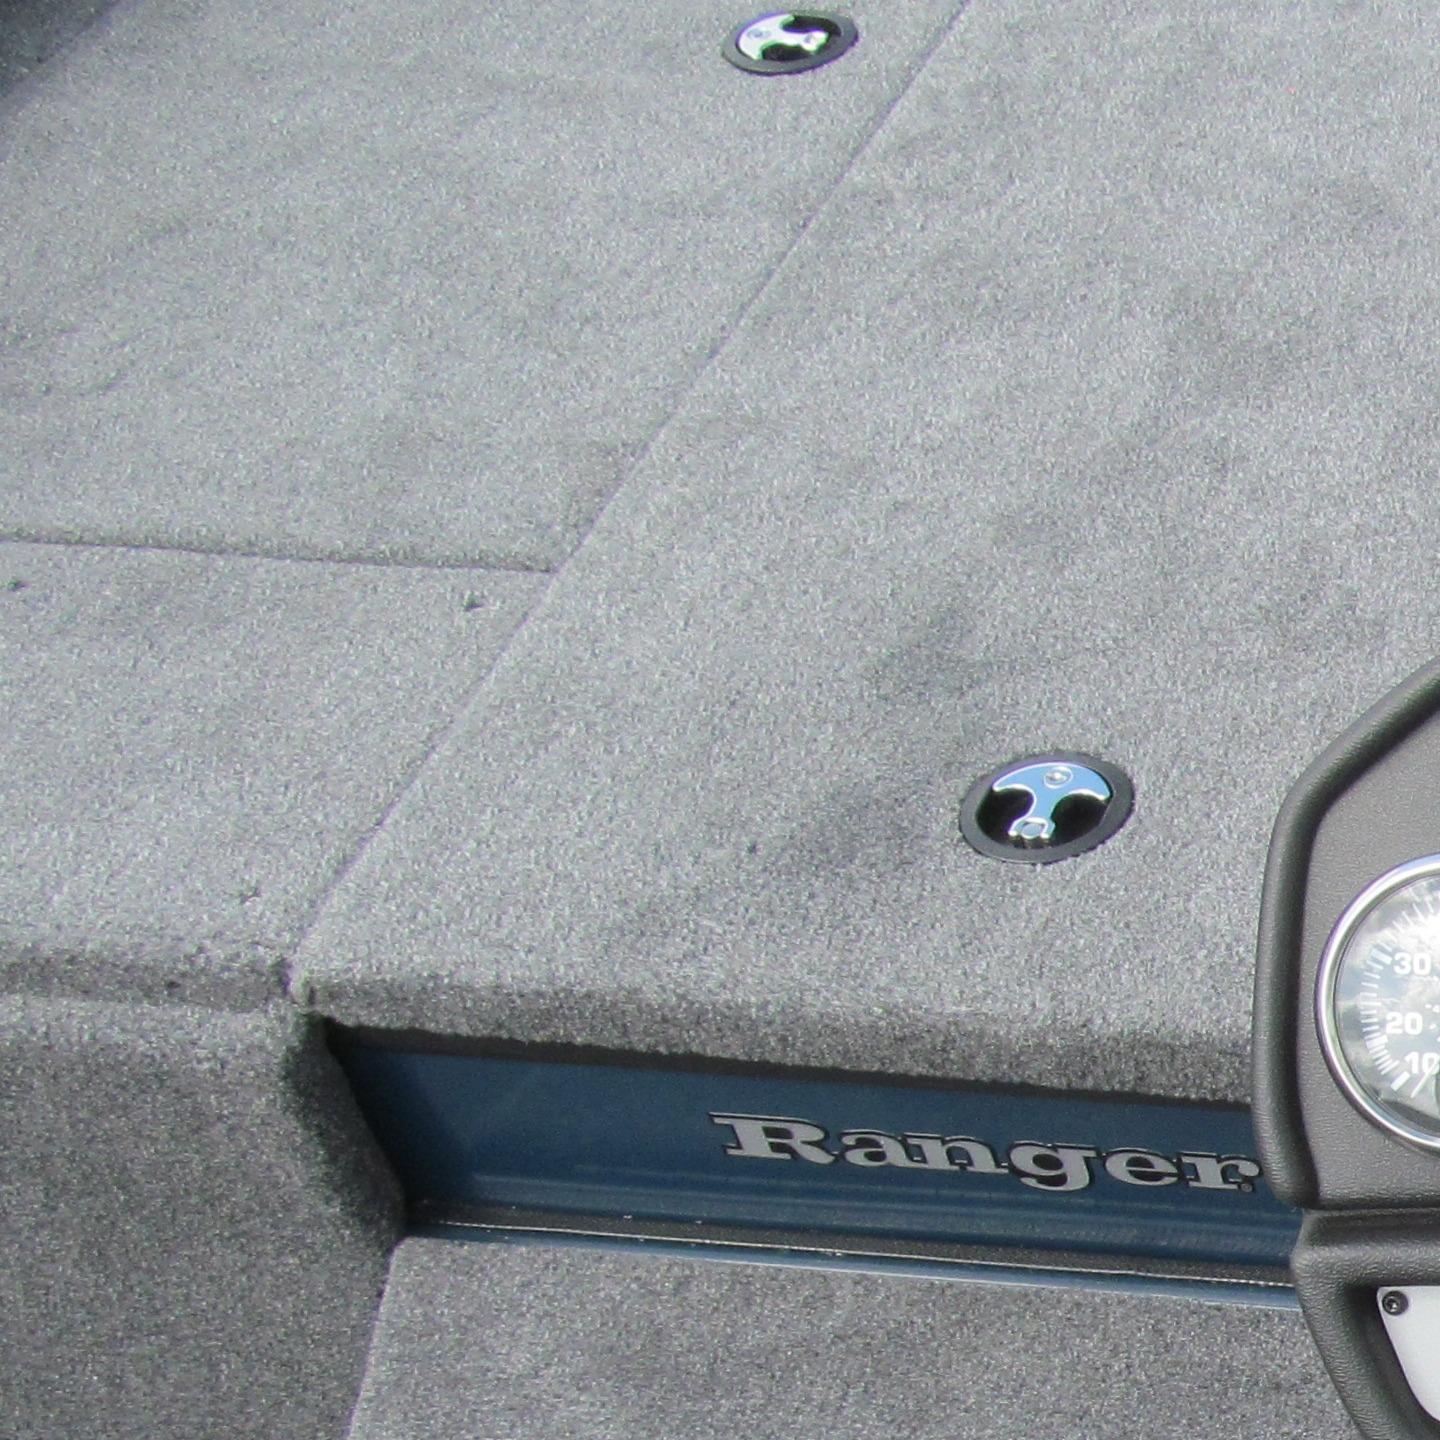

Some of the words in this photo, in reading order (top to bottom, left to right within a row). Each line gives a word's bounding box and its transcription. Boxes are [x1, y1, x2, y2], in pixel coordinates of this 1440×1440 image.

[1393, 952, 1432, 976] 30
[1385, 1012, 1424, 1036] 20
[1404, 1052, 1440, 1075] 10
[708, 1110, 1264, 1193] Ranger
